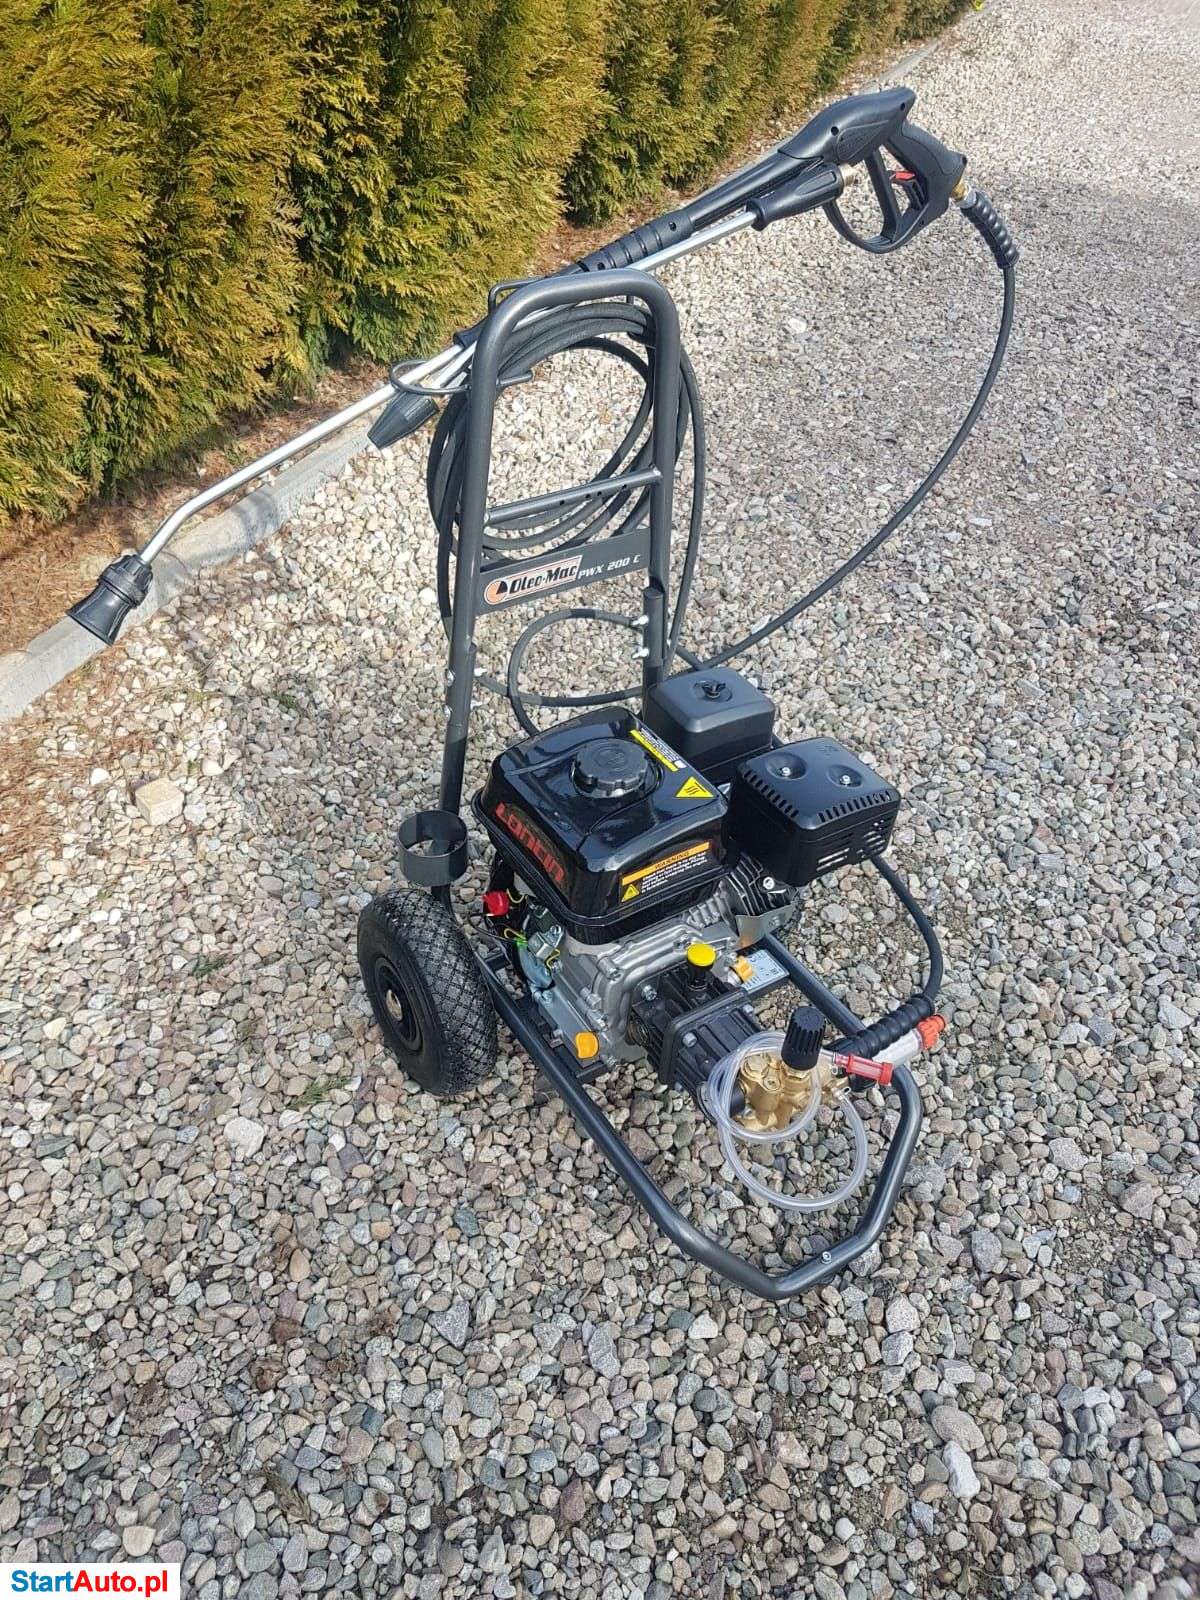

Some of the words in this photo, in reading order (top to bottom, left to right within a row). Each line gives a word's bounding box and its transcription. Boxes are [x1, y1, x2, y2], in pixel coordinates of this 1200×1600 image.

[578, 566, 604, 579] PWX
[607, 558, 630, 570] 200
[632, 554, 641, 564] C
